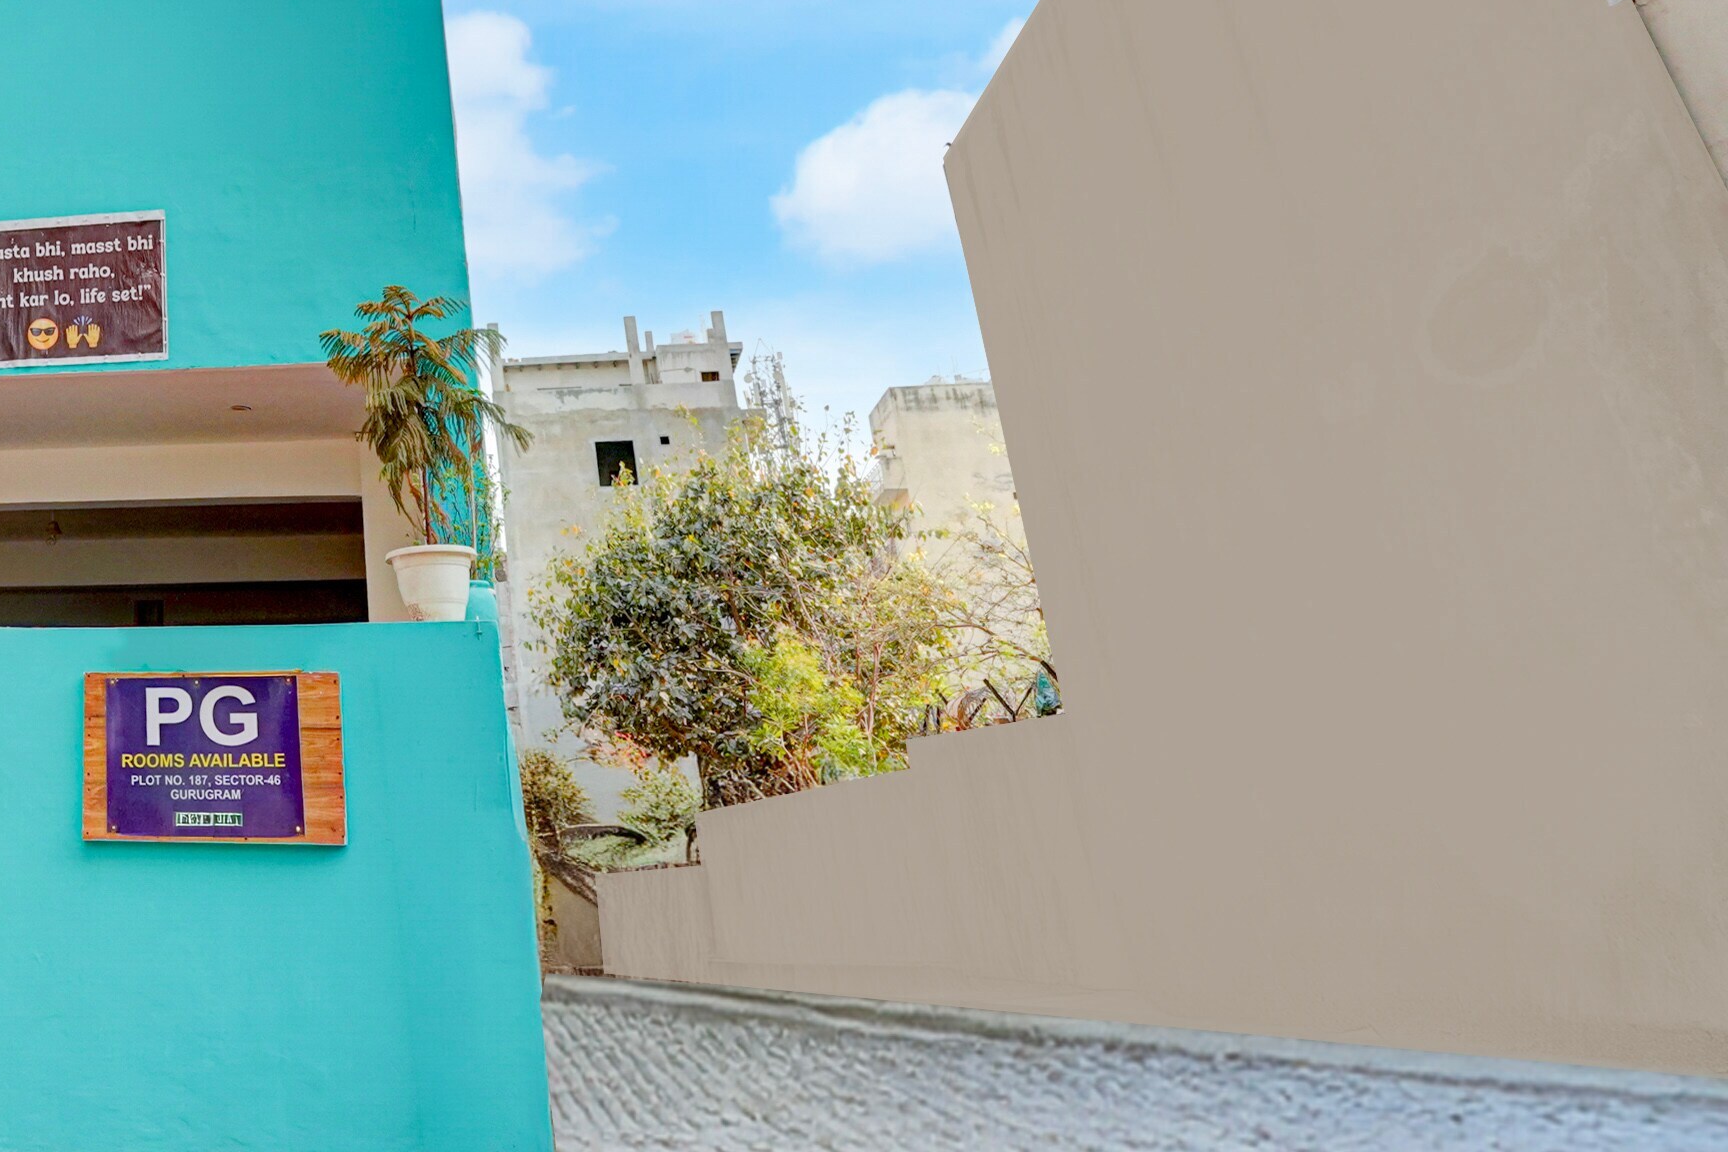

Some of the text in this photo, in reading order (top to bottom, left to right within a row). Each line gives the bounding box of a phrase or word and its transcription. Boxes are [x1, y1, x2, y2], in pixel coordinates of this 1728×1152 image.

[35, 241, 65, 258] bhi,
[71, 238, 122, 255] masst
[127, 234, 153, 251] bhi
[13, 263, 115, 283] khush raho,
[19, 292, 48, 308] kar
[54, 290, 74, 307] lo,
[80, 287, 106, 305] life
[145, 685, 259, 747] PG
[121, 752, 286, 768] ROOMS AVAILABLE
[130, 774, 281, 788] PLOT NO. 187, SECTOR-46
[170, 788, 242, 800] GURUGRAM
